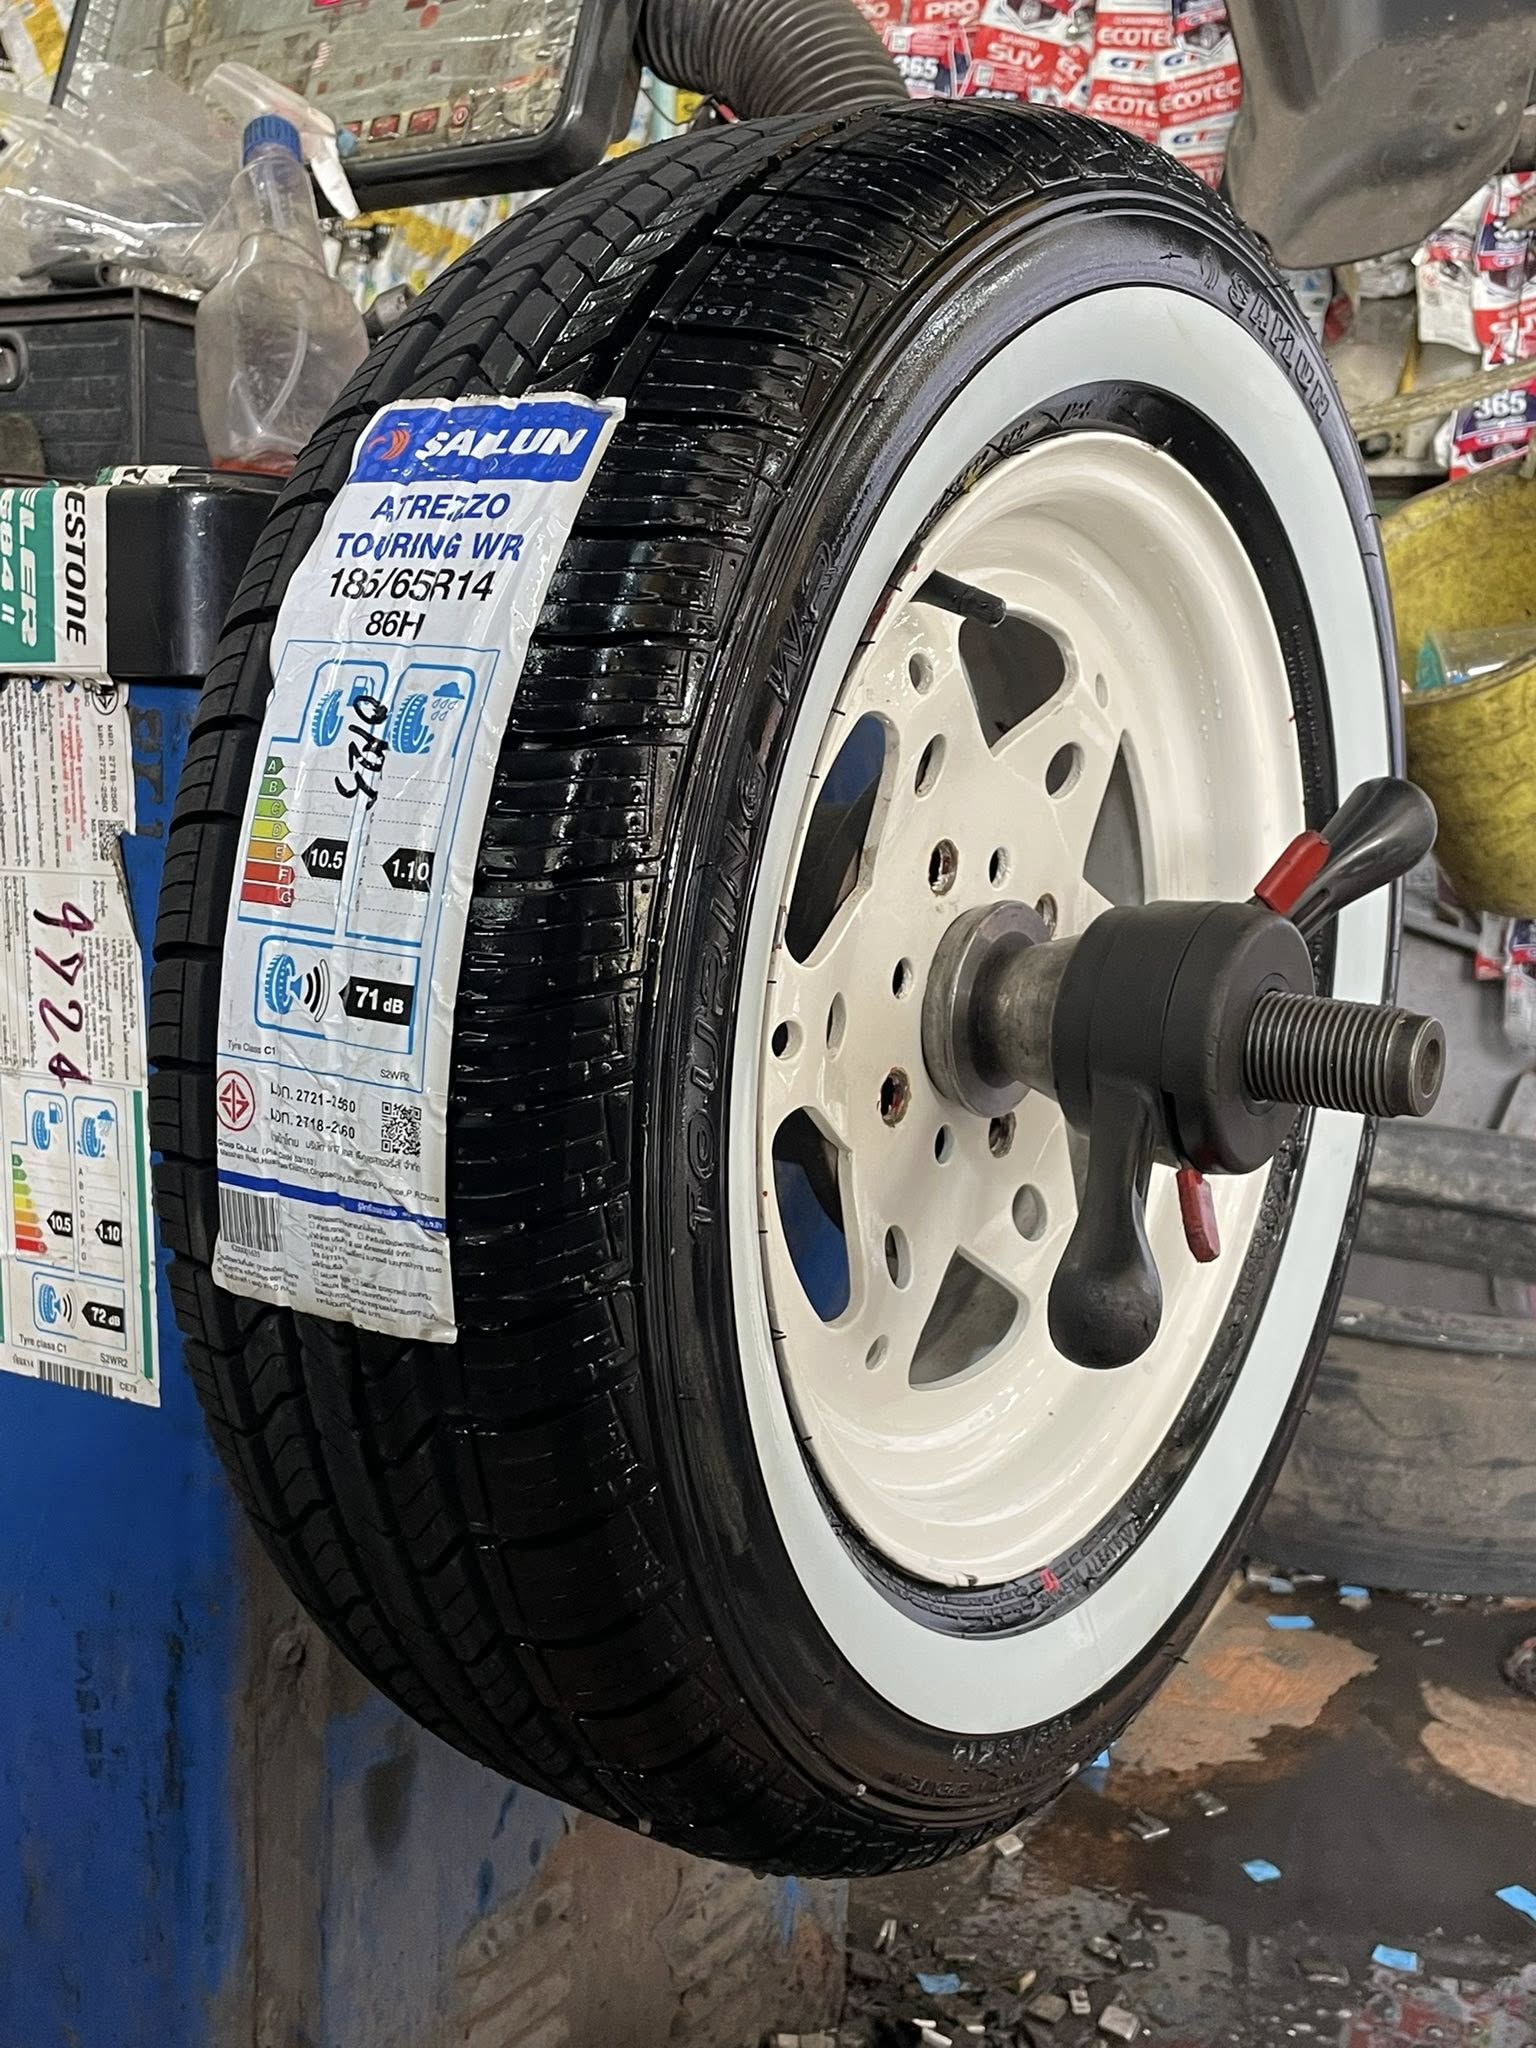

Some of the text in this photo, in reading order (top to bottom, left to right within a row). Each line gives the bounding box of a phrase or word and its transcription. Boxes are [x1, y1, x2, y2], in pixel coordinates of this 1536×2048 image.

[986, 42, 1045, 70] SUV
[1159, 77, 1241, 114] ECOTEC
[1474, 391, 1527, 420] 365
[414, 426, 588, 462] SAILUN
[370, 493, 512, 523] ATREZZO
[335, 533, 525, 562] TOURING WR
[329, 566, 494, 602] 185/65R14
[365, 609, 426, 641] 86H
[267, 760, 276, 772] A
[269, 781, 278, 793] B
[272, 803, 281, 815] C
[311, 849, 344, 870] 10.5
[278, 868, 289, 881] F
[391, 859, 430, 882] 1.10
[280, 890, 292, 904] G
[355, 985, 404, 1015] 71 dB
[264, 1046, 276, 1056] C1
[50, 1214, 72, 1232] 10.5
[98, 1224, 120, 1241] 1.10
[91, 1307, 121, 1327] 72 dB
[19, 1334, 67, 1353] Tyre class C1
[100, 1353, 128, 1368] S2WR2
